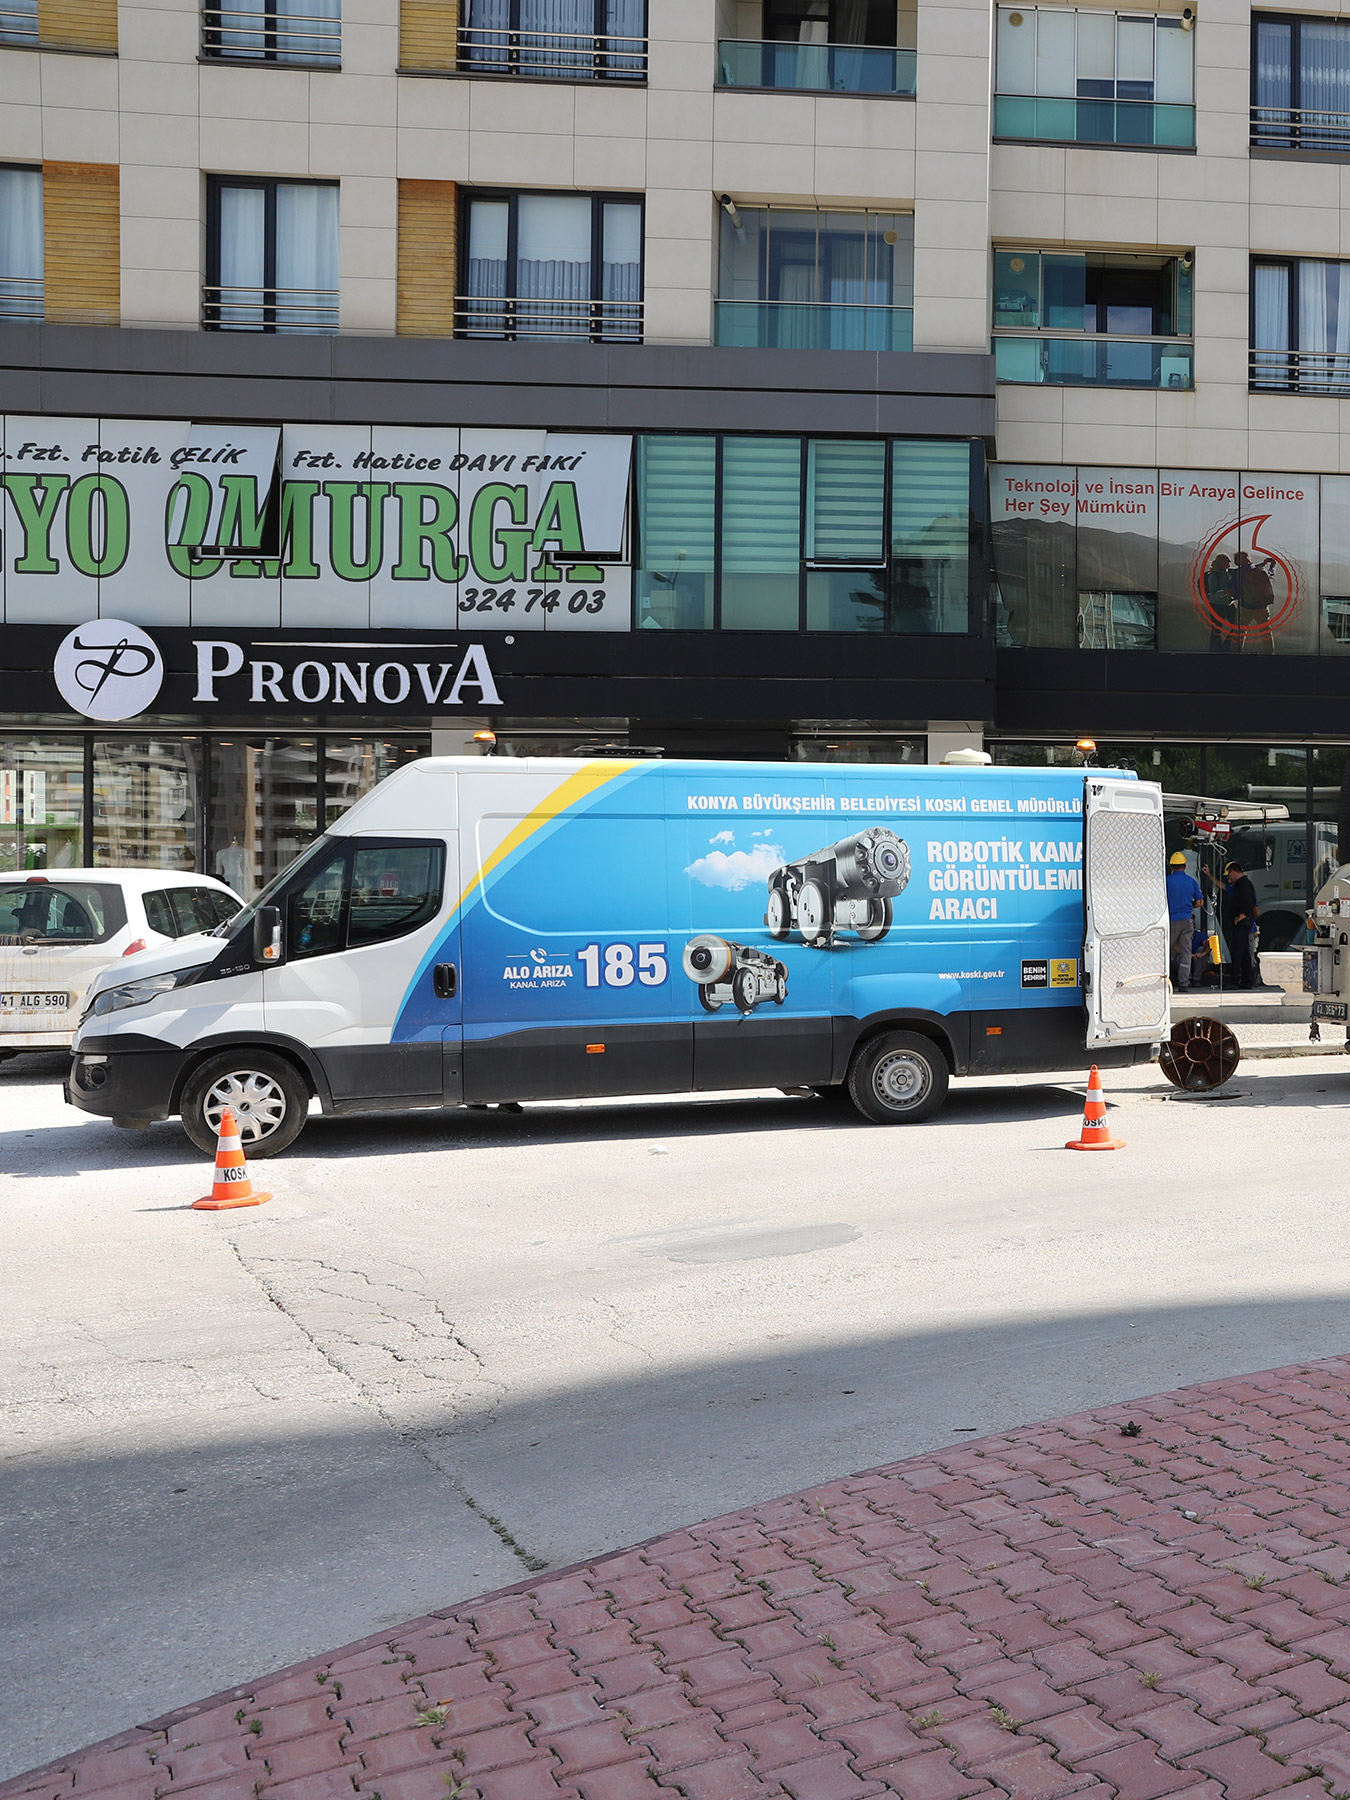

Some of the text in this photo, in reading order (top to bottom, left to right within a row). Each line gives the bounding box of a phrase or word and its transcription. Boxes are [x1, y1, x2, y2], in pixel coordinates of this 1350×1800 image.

[81, 444, 162, 464] Fatih
[169, 443, 248, 470] ÇELİK
[292, 450, 587, 473] Fzt. Hatice DAYI FAKİ
[1004, 477, 1305, 502] Teknoloji ve İnsan Bir Araya Gelince
[1004, 498, 1147, 516] Her Şey Mümkün
[0, 472, 605, 584] YO OMURGA
[458, 588, 606, 614] 324 74 03
[687, 793, 1083, 815] KONYA BÜYÜKŞEHİR BELEDİYESİ KOSKİ GENEL MÜDÜRLÜ
[926, 836, 1025, 863] ROBOTİK
[928, 897, 998, 920] ARACI
[503, 965, 573, 980] ALO ARIZA
[577, 943, 668, 988] 185
[938, 969, 1006, 980] www.koski.gov.tr
[1023, 966, 1047, 974] BENİM
[510, 980, 567, 989] KANAL ARIZA
[1023, 974, 1047, 982] ŞEHRİM
[1, 995, 65, 1006] 41 ALG 590
